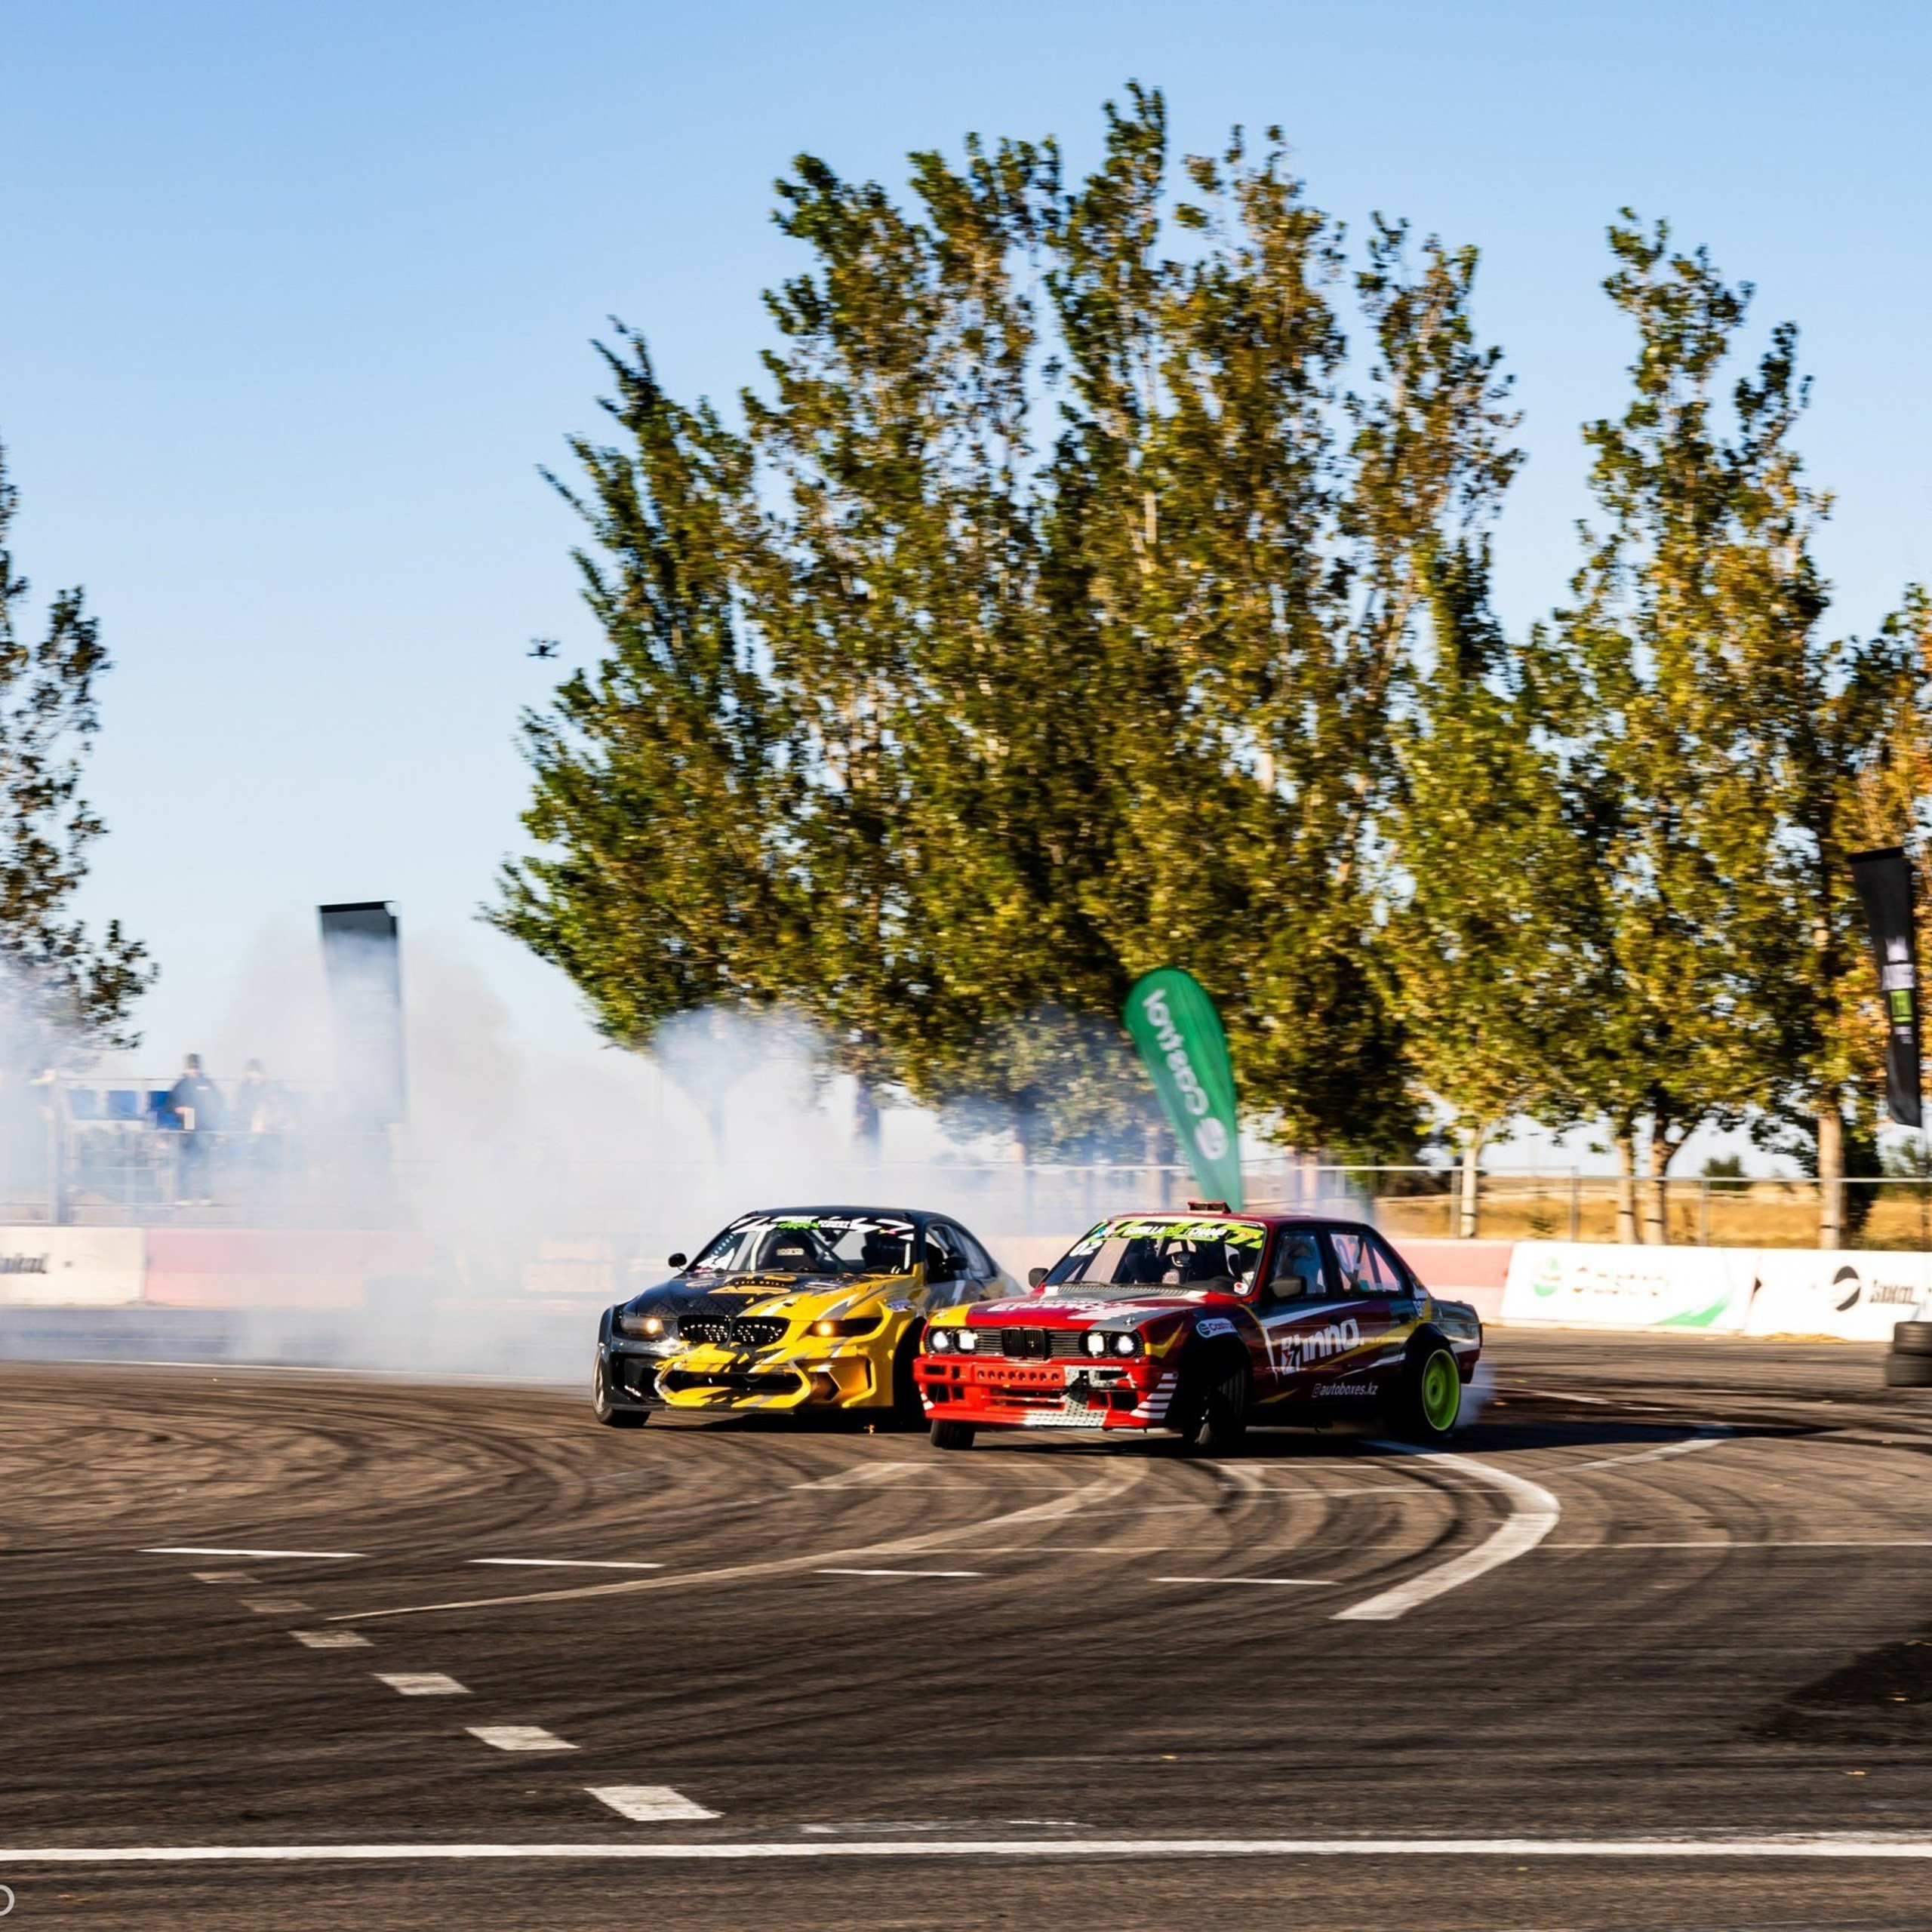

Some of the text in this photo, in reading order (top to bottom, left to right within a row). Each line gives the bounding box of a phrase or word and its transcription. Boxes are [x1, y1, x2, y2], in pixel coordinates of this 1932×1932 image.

[1069, 1240, 1103, 1257] 02
[1335, 1237, 1364, 1274] 02
[1311, 1382, 1379, 1398] @autoboxes.kz
